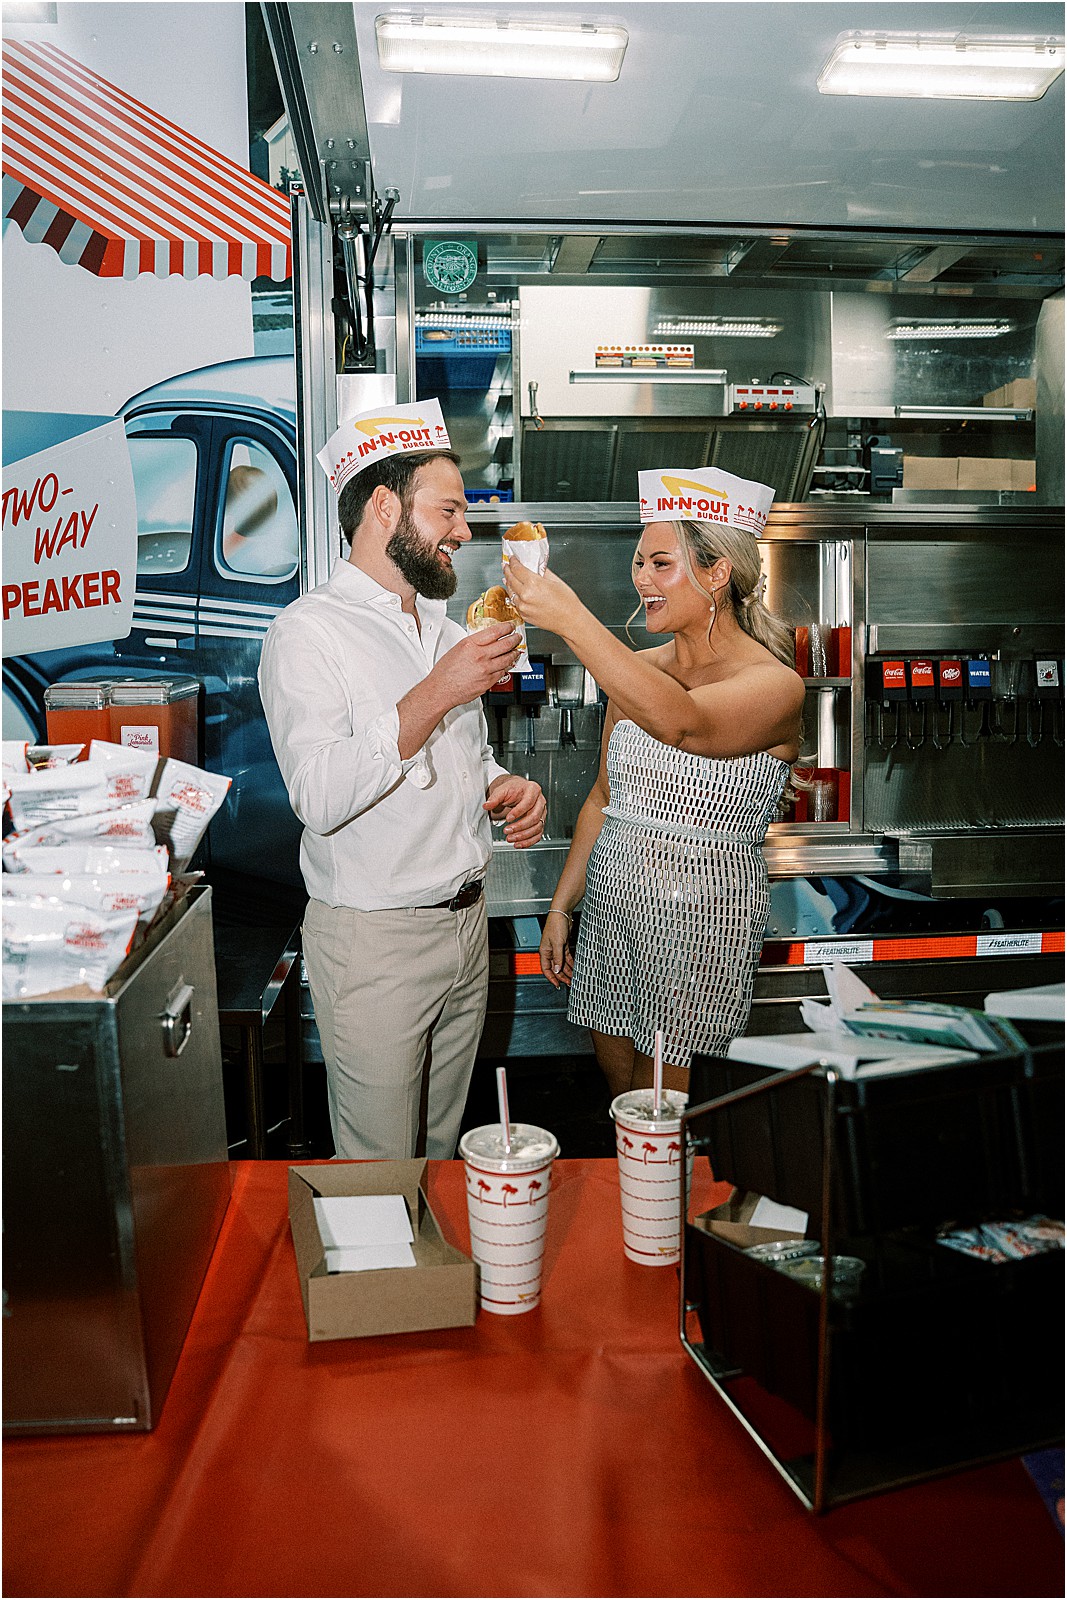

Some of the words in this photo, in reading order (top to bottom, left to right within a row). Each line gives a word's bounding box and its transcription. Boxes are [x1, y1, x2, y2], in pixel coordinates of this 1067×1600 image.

[427, 245, 445, 274] COUNTY
[457, 245, 476, 274] ORANGE
[431, 276, 472, 291] CALIFORNIA
[438, 273, 465, 282] PASS
[357, 428, 431, 458] IN-N-OUT
[402, 440, 435, 450] BURGER
[657, 497, 730, 516] IN-N-OUT
[697, 511, 729, 523] BURGER
[34, 503, 99, 565] WAY
[2, 569, 122, 620] PEAKER
[133, 733, 149, 741] Pink
[994, 939, 1029, 948] FEATHERLITE
[822, 947, 859, 956] FEATHERLITE
